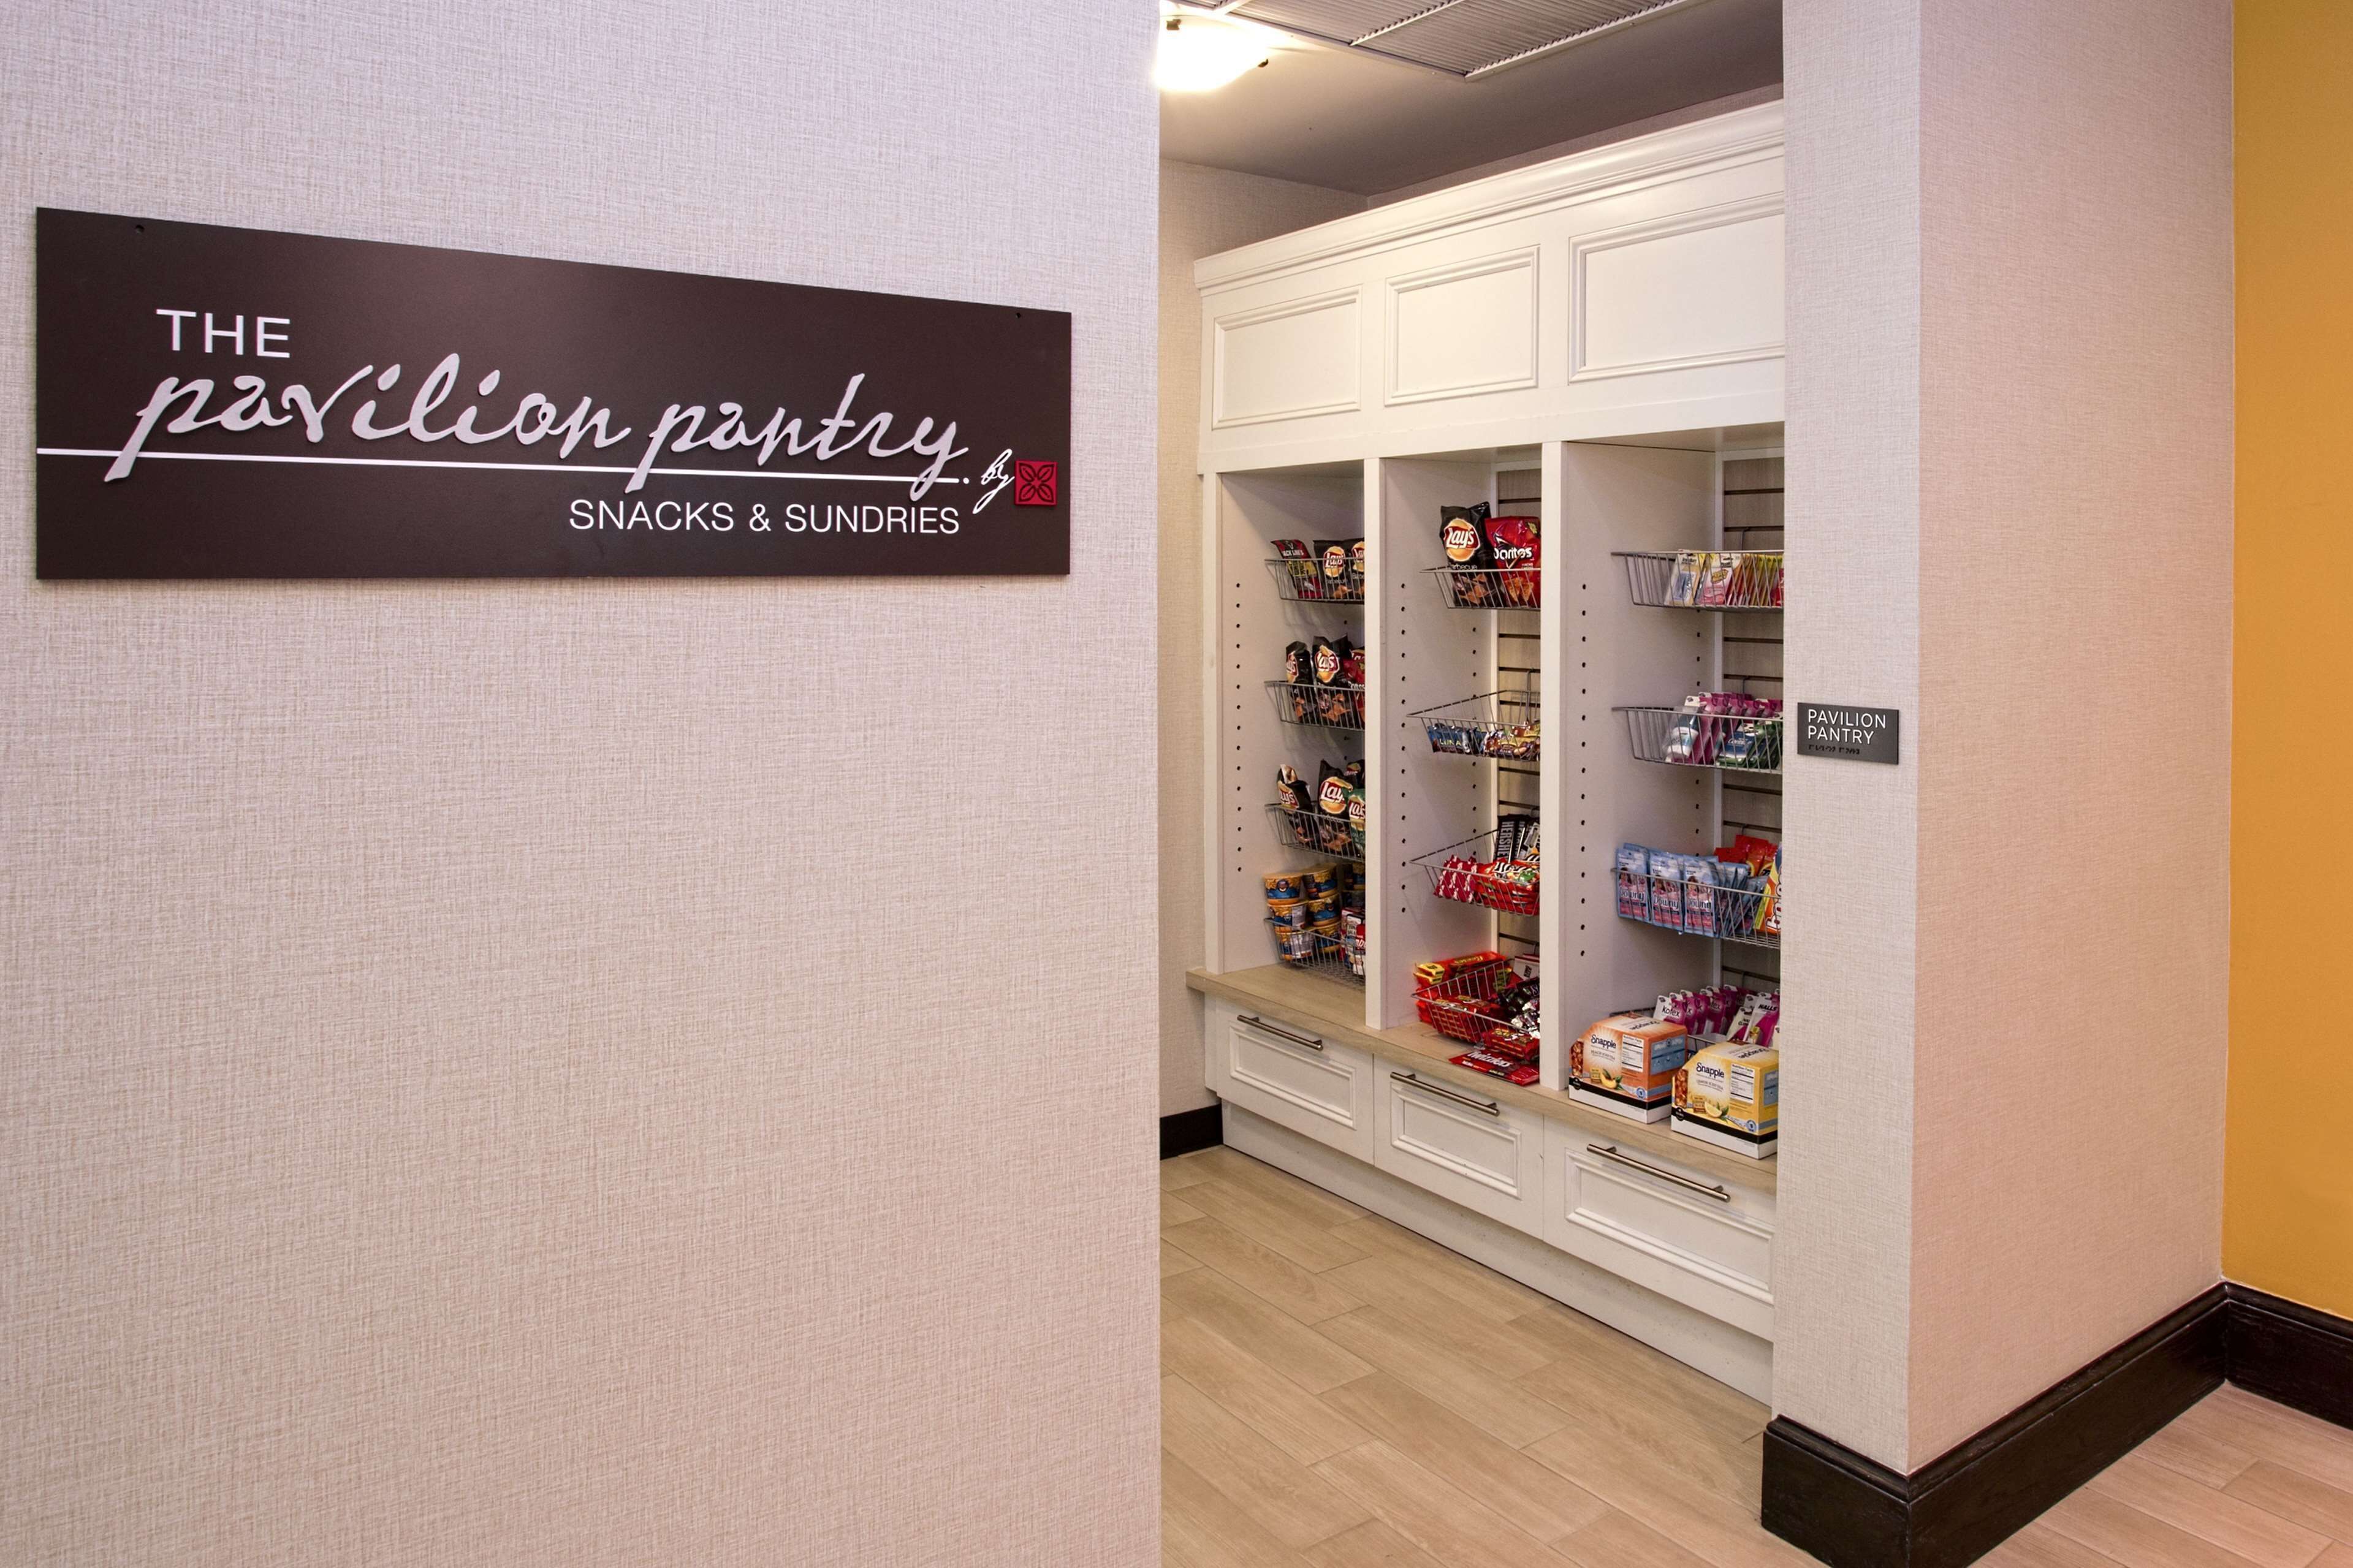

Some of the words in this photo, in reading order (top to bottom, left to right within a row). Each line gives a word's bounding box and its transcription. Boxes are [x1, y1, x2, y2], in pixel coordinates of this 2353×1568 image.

[156, 309, 291, 358] THE
[104, 353, 631, 482] pavilion
[973, 449, 1015, 513] by
[569, 499, 734, 531] SNACKS
[749, 504, 772, 532] &
[785, 504, 959, 534] SUNDRIES
[1446, 528, 1475, 550] Lay's
[1808, 709, 1886, 729] PAVILION
[1808, 725, 1874, 744] PANTRY
[1497, 821, 1515, 859] HERSHE
[1591, 1034, 1617, 1049] Snapple
[1696, 1062, 1725, 1078] Snapple
